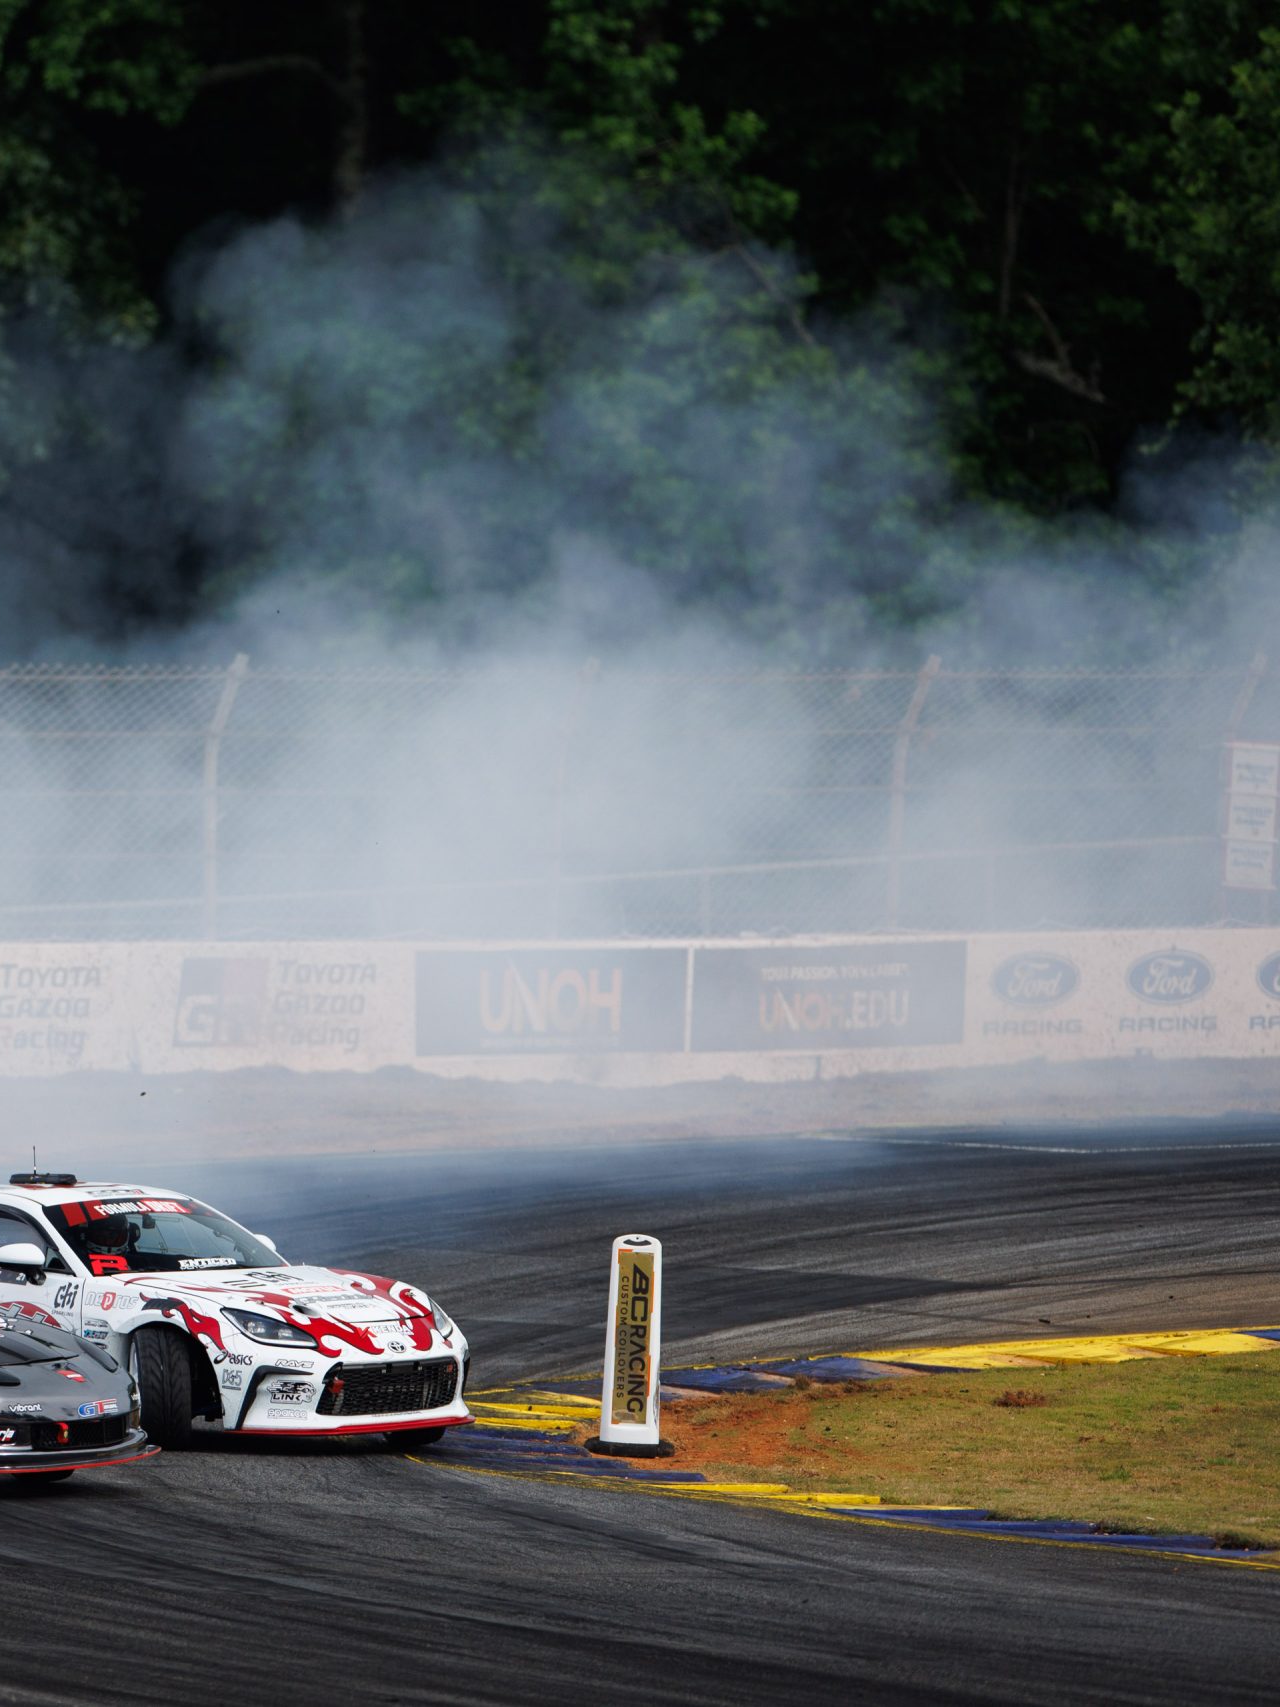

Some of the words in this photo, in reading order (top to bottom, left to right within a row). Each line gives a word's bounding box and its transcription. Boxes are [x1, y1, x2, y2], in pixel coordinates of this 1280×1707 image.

[0, 962, 102, 988] TOYOTA
[278, 959, 377, 985] TOYOTA
[1007, 959, 1063, 998] Ford
[1142, 957, 1197, 996] Ford
[479, 959, 623, 1034] UNOH
[982, 1018, 1084, 1035] RACING
[1119, 1015, 1218, 1032] RACING
[620, 1275, 630, 1327] CUSTOM
[229, 1353, 253, 1366] asics
[275, 1358, 314, 1369] RAYS
[616, 1330, 628, 1399] COILOVERS
[626, 1324, 648, 1414] RACING
[272, 1392, 302, 1401] LINK
[268, 1408, 307, 1419] sparco
